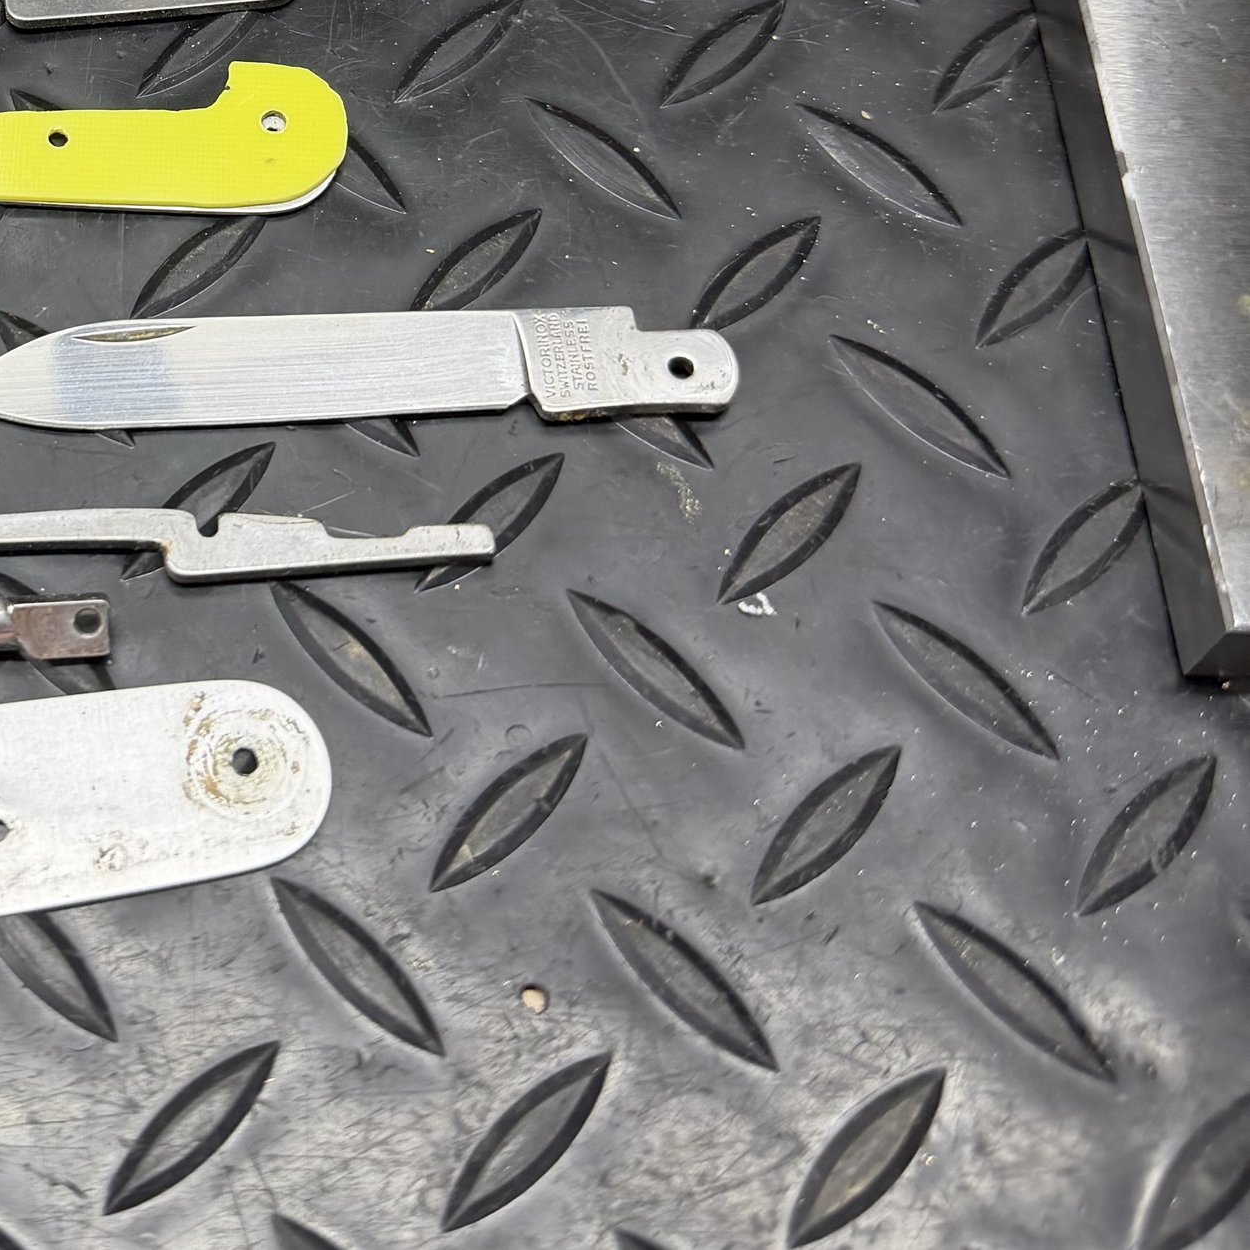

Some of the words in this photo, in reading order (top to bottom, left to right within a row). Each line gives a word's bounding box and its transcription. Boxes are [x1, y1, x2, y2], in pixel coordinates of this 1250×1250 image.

[533, 313, 556, 399] VICTORINOX
[547, 312, 571, 398] SWITZERLAND
[563, 320, 584, 391] STAINLESS
[576, 318, 599, 391] ROSTFREI
